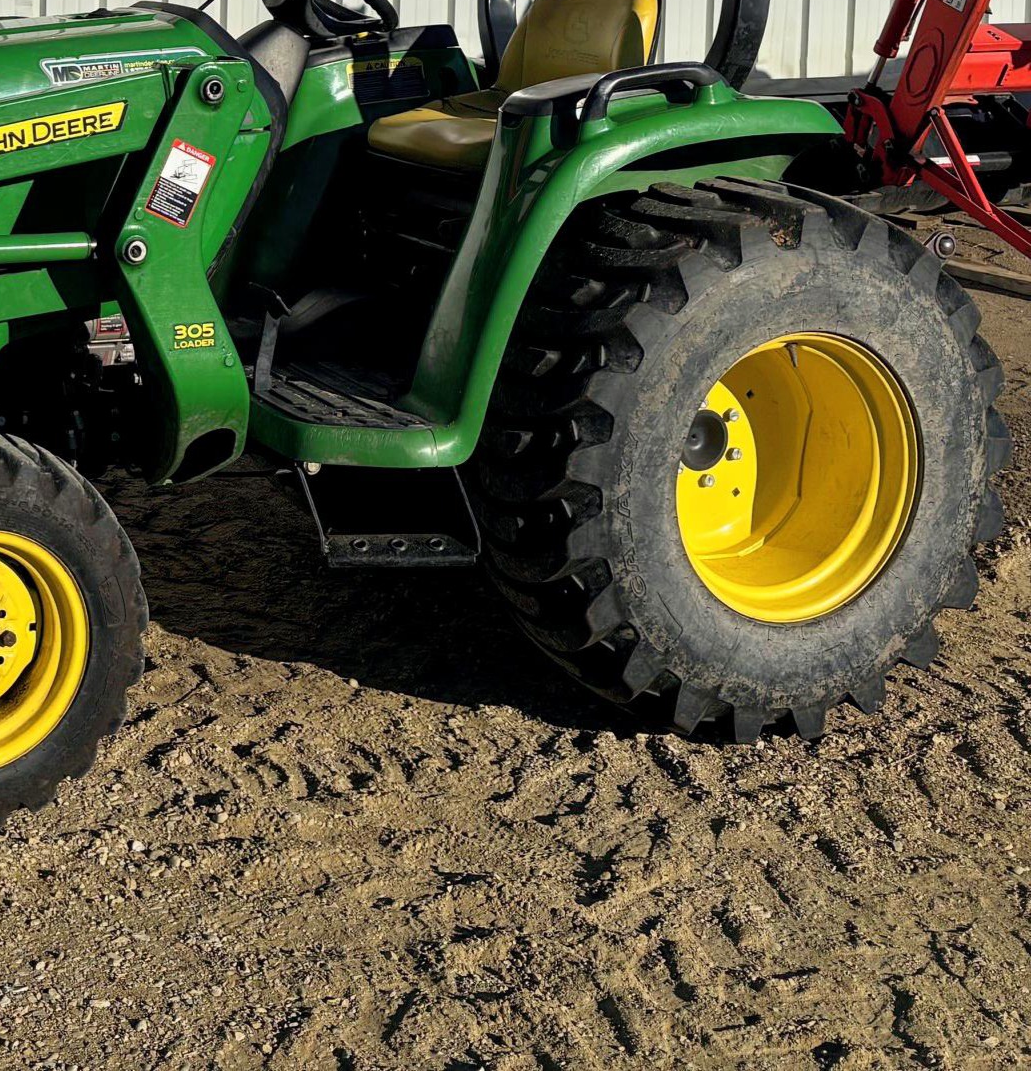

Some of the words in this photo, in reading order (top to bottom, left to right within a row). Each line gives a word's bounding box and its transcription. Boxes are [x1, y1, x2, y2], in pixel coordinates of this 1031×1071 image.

[83, 63, 120, 72] MARTIN
[31, 111, 115, 143] DEERE
[186, 146, 211, 163] DANGER
[174, 322, 215, 340] 305
[174, 338, 215, 349] LOADER
